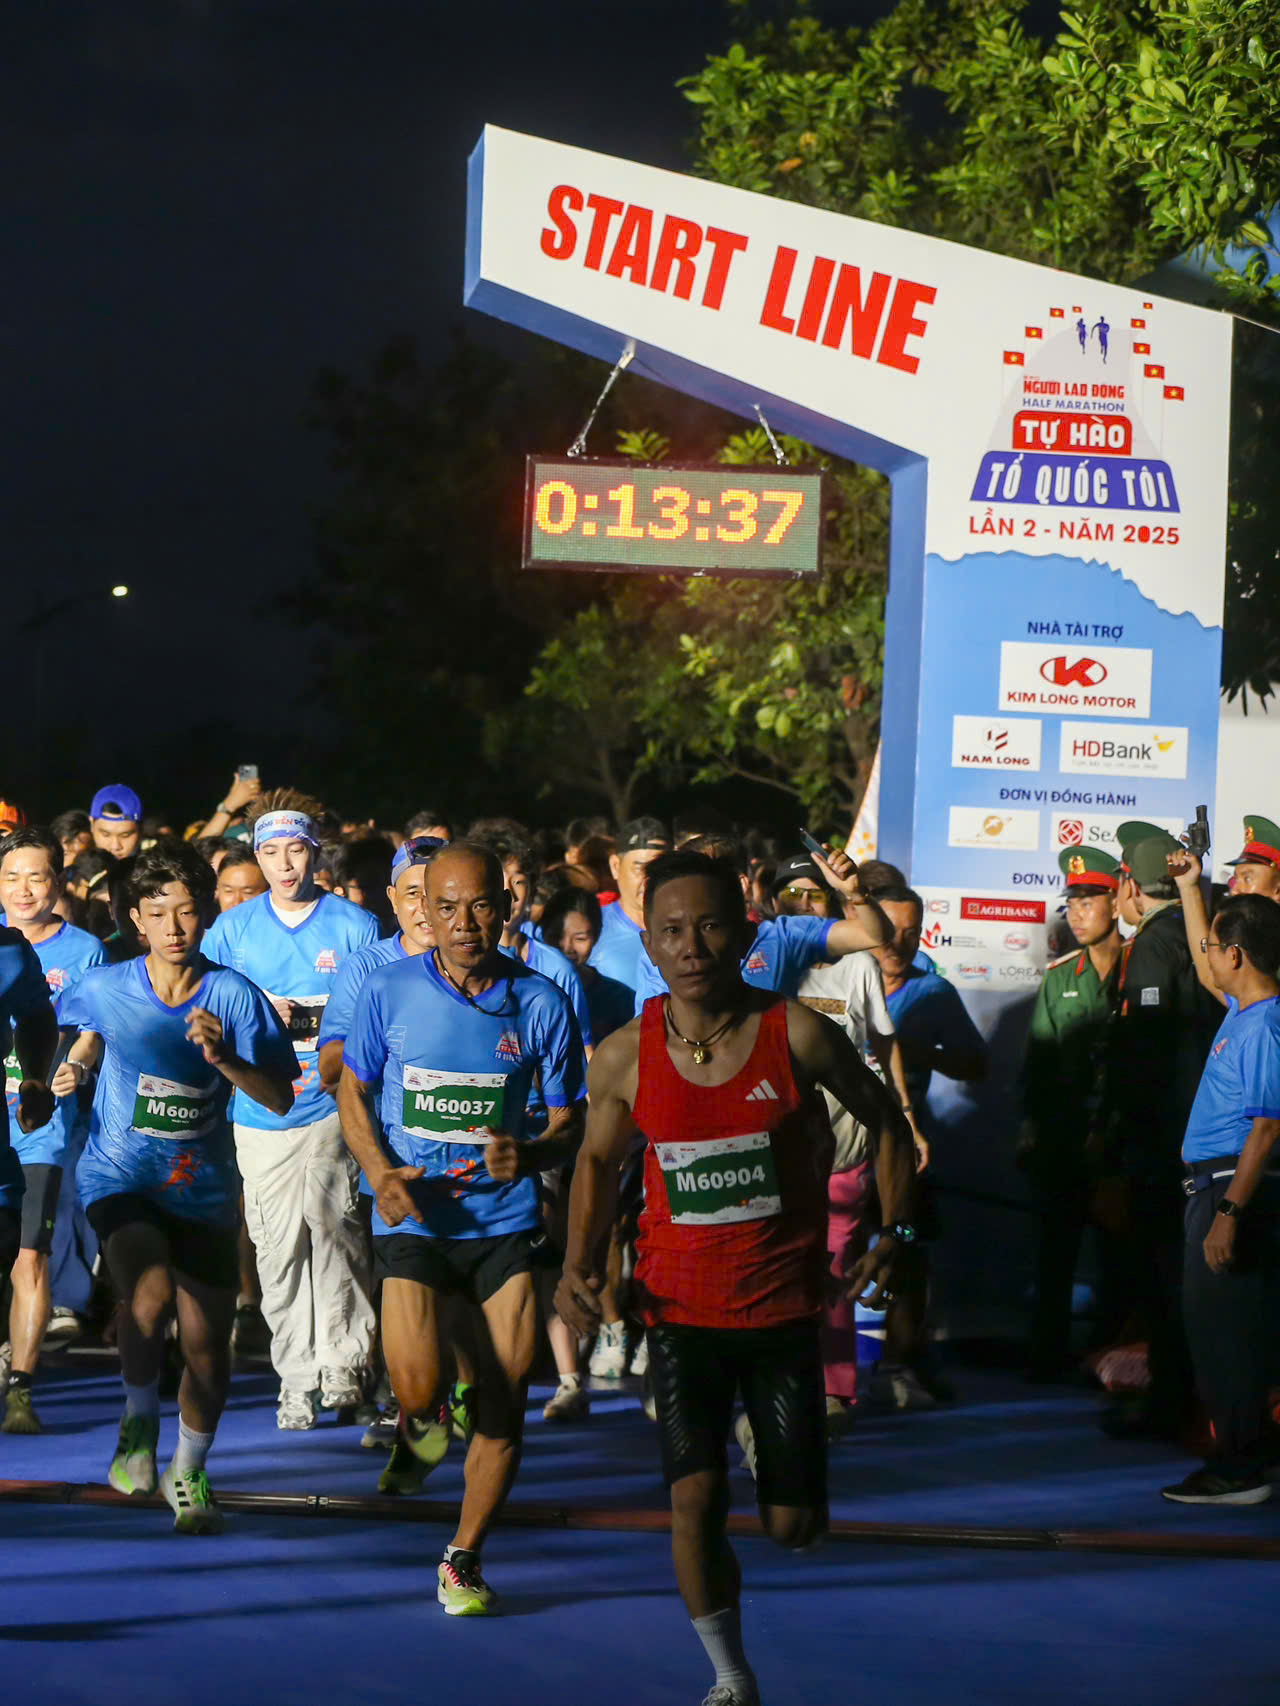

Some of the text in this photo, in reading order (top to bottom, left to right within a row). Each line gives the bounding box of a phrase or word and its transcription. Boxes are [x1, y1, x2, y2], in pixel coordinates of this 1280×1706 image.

[540, 184, 938, 375] START LINE
[1065, 383, 1088, 397] LAO
[1022, 397, 1125, 413] HALF MARATHON
[1020, 415, 1126, 449] TỰ HÀO
[1034, 459, 1109, 505] QUỐC
[1122, 465, 1170, 508] TÔI
[534, 480, 804, 544] 0:13:37
[1023, 519, 1036, 537] 2
[1059, 517, 1114, 542] NĂM
[1123, 525, 1180, 545] 2025
[1027, 620, 1124, 642] NHÀ TÀI TRỢ
[1007, 691, 1136, 709] KIM LONG MOTOR
[961, 755, 1030, 765] NAM LONG
[1072, 740, 1152, 760] HDBank
[999, 788, 1031, 800] ĐƠN
[1096, 791, 1136, 806] HÀNH
[1012, 873, 1044, 885] ĐƠN
[980, 904, 1038, 918] AGRIBANK
[415, 1093, 495, 1115] M60037
[676, 1165, 765, 1192] M60904
